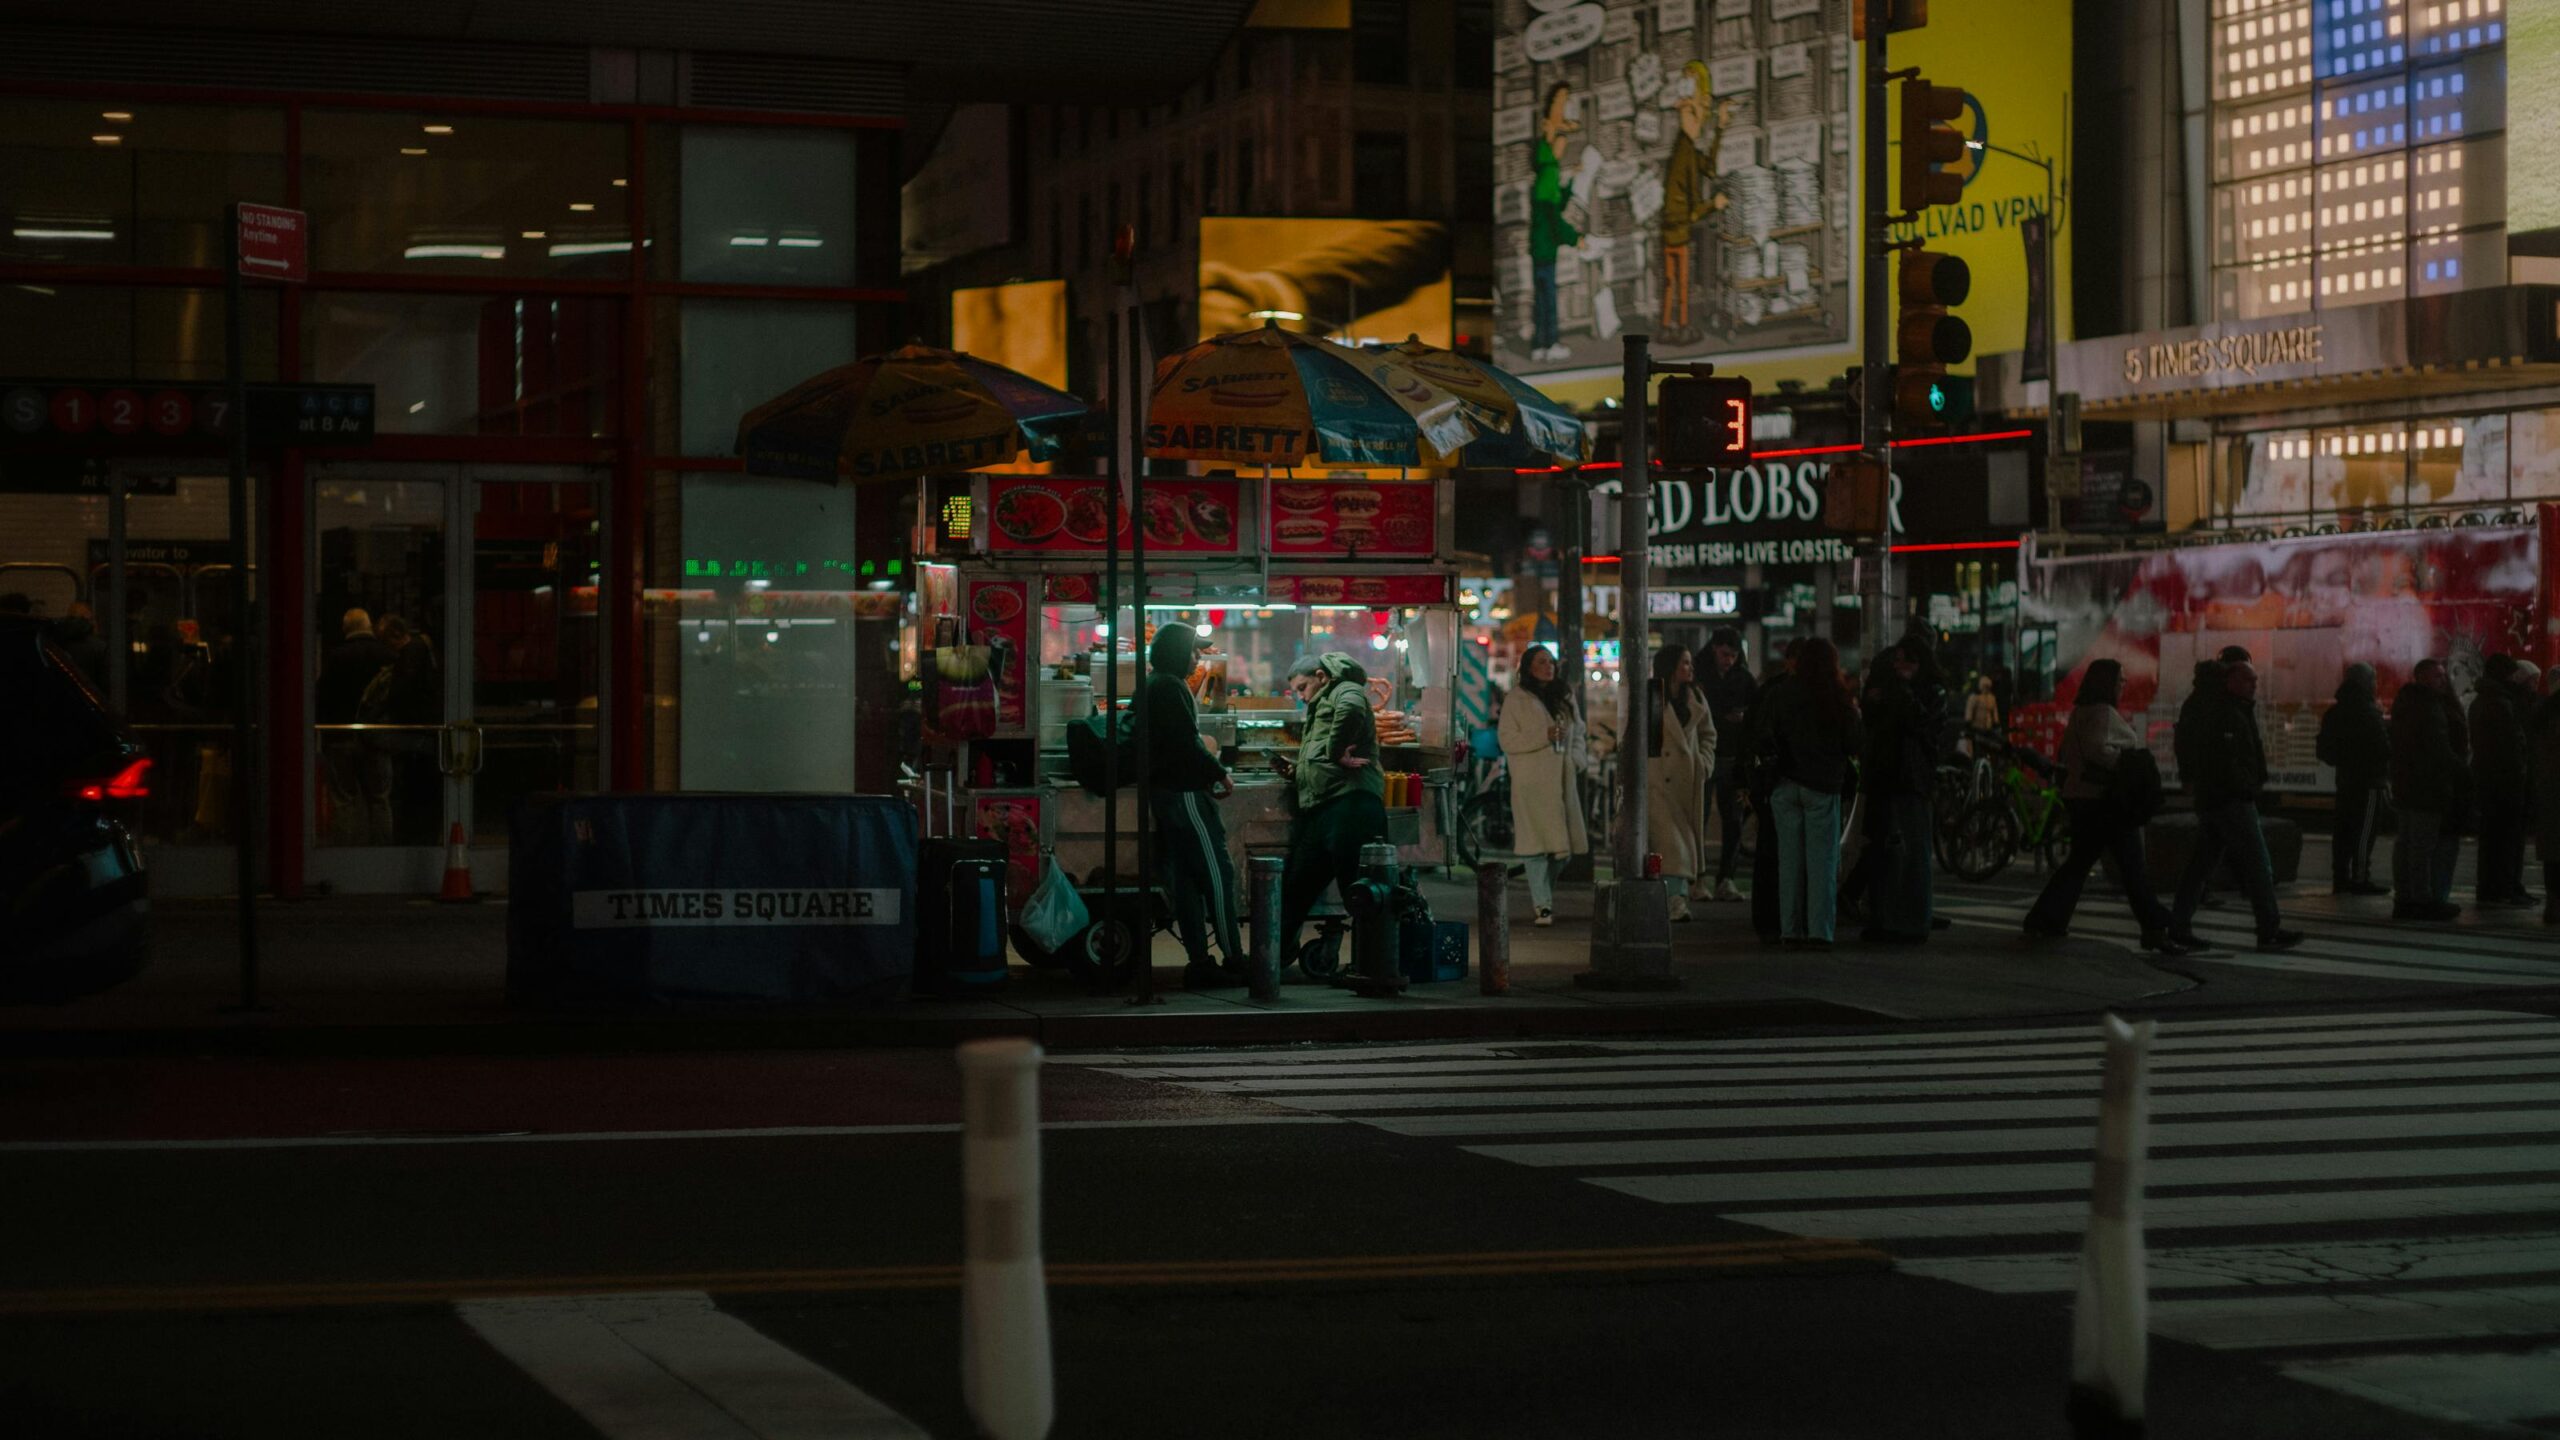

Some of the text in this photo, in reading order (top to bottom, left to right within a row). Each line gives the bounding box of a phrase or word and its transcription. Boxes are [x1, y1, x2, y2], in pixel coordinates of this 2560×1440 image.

[241, 211, 297, 231] NO STANDING
[1994, 195, 2043, 228] VPN
[243, 227, 278, 246] Anytime
[2124, 325, 2324, 384] 5 TIMES SQUARE
[1182, 371, 1289, 393] SABRETT
[14, 397, 230, 428] S 1 2 3 7
[1726, 399, 1746, 452] 3
[1145, 423, 1303, 453] SABRETT
[853, 430, 1008, 477] SABRETT
[1701, 460, 1906, 535] LOBSR
[171, 544, 189, 559] to
[1648, 543, 1696, 568] FRESH
[1697, 542, 1736, 567] FISH
[1743, 540, 1779, 565] LIVE
[607, 891, 874, 921] TIMES SQUARE
